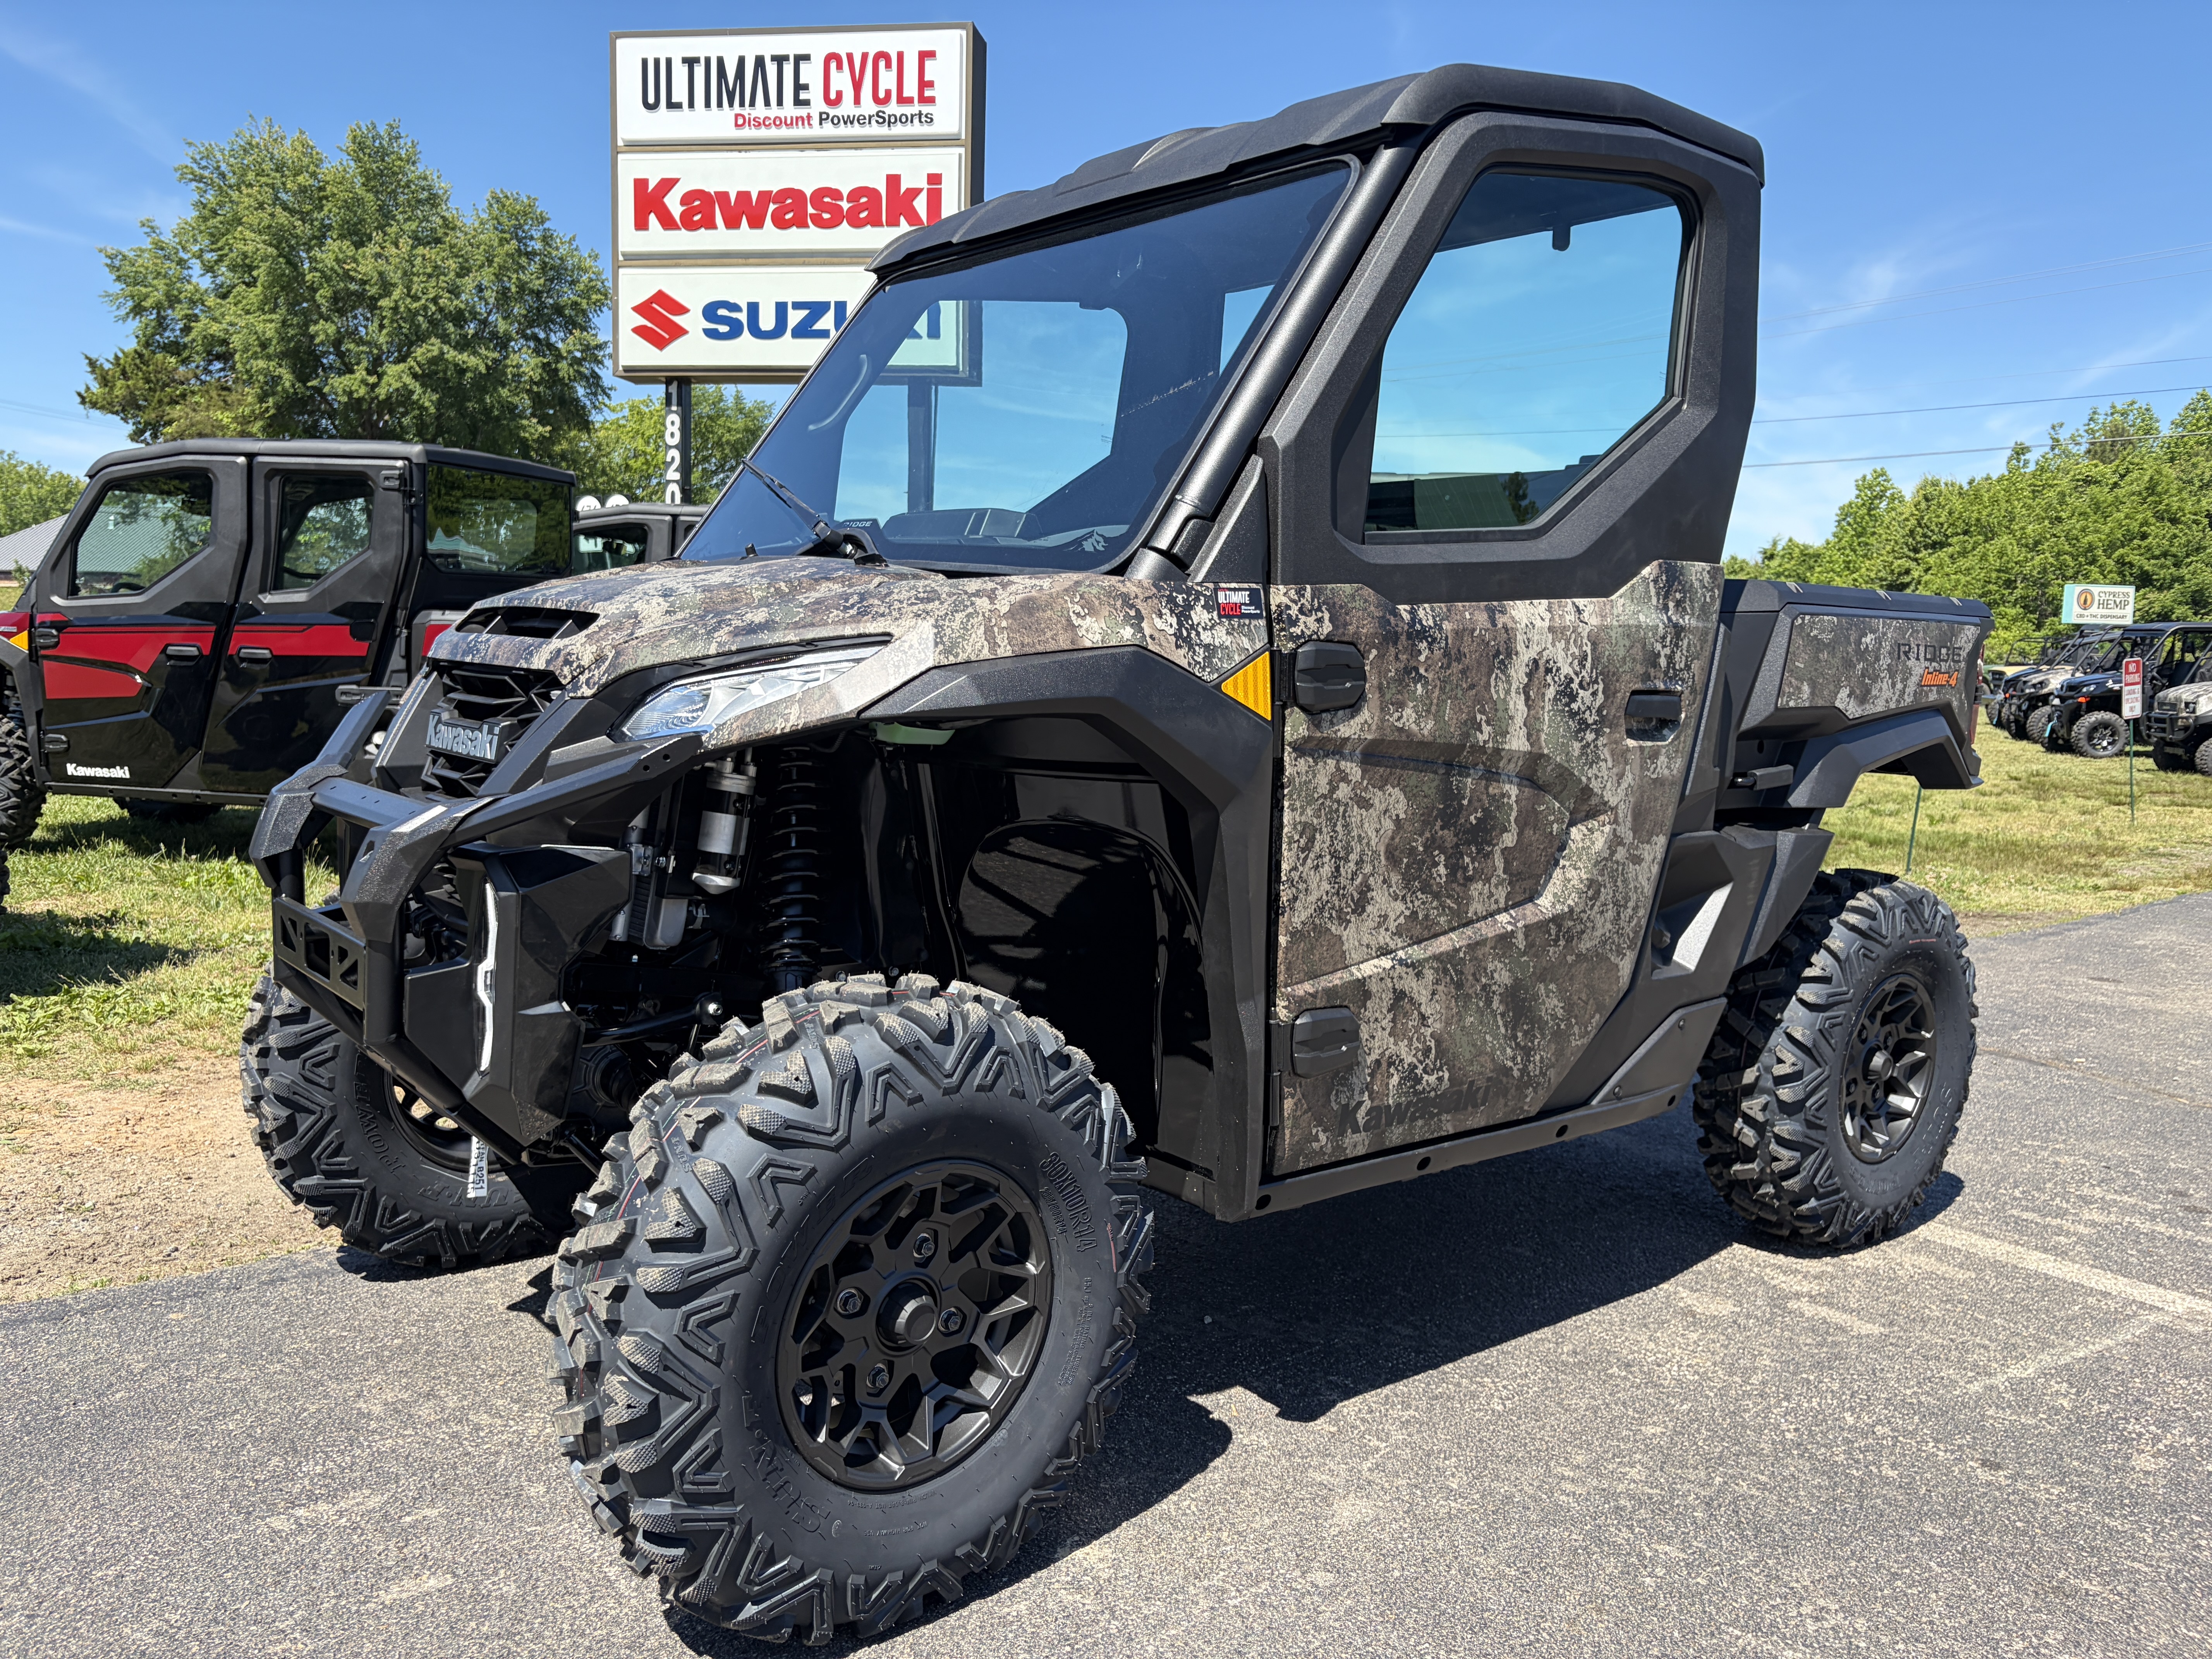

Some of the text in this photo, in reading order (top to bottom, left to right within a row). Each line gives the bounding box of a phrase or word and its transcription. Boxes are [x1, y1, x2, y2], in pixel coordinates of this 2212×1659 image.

[641, 50, 936, 110] ULTIMATE CYCLE
[734, 111, 934, 128] Discount PowerSports
[634, 173, 942, 231] Kawasaki
[1218, 591, 1250, 603] ULTIMATE
[2097, 599, 2130, 610] HEMP
[1221, 603, 1241, 615] CYCLE
[1898, 643, 1962, 663] RIDGE
[2129, 663, 2136, 672] NO
[2125, 673, 2140, 683] PARKING
[426, 714, 500, 760] Kawasaki
[66, 763, 130, 778] Kawasaki
[1338, 1076, 1493, 1137] Kawasaki
[475, 1166, 485, 1189] B251
